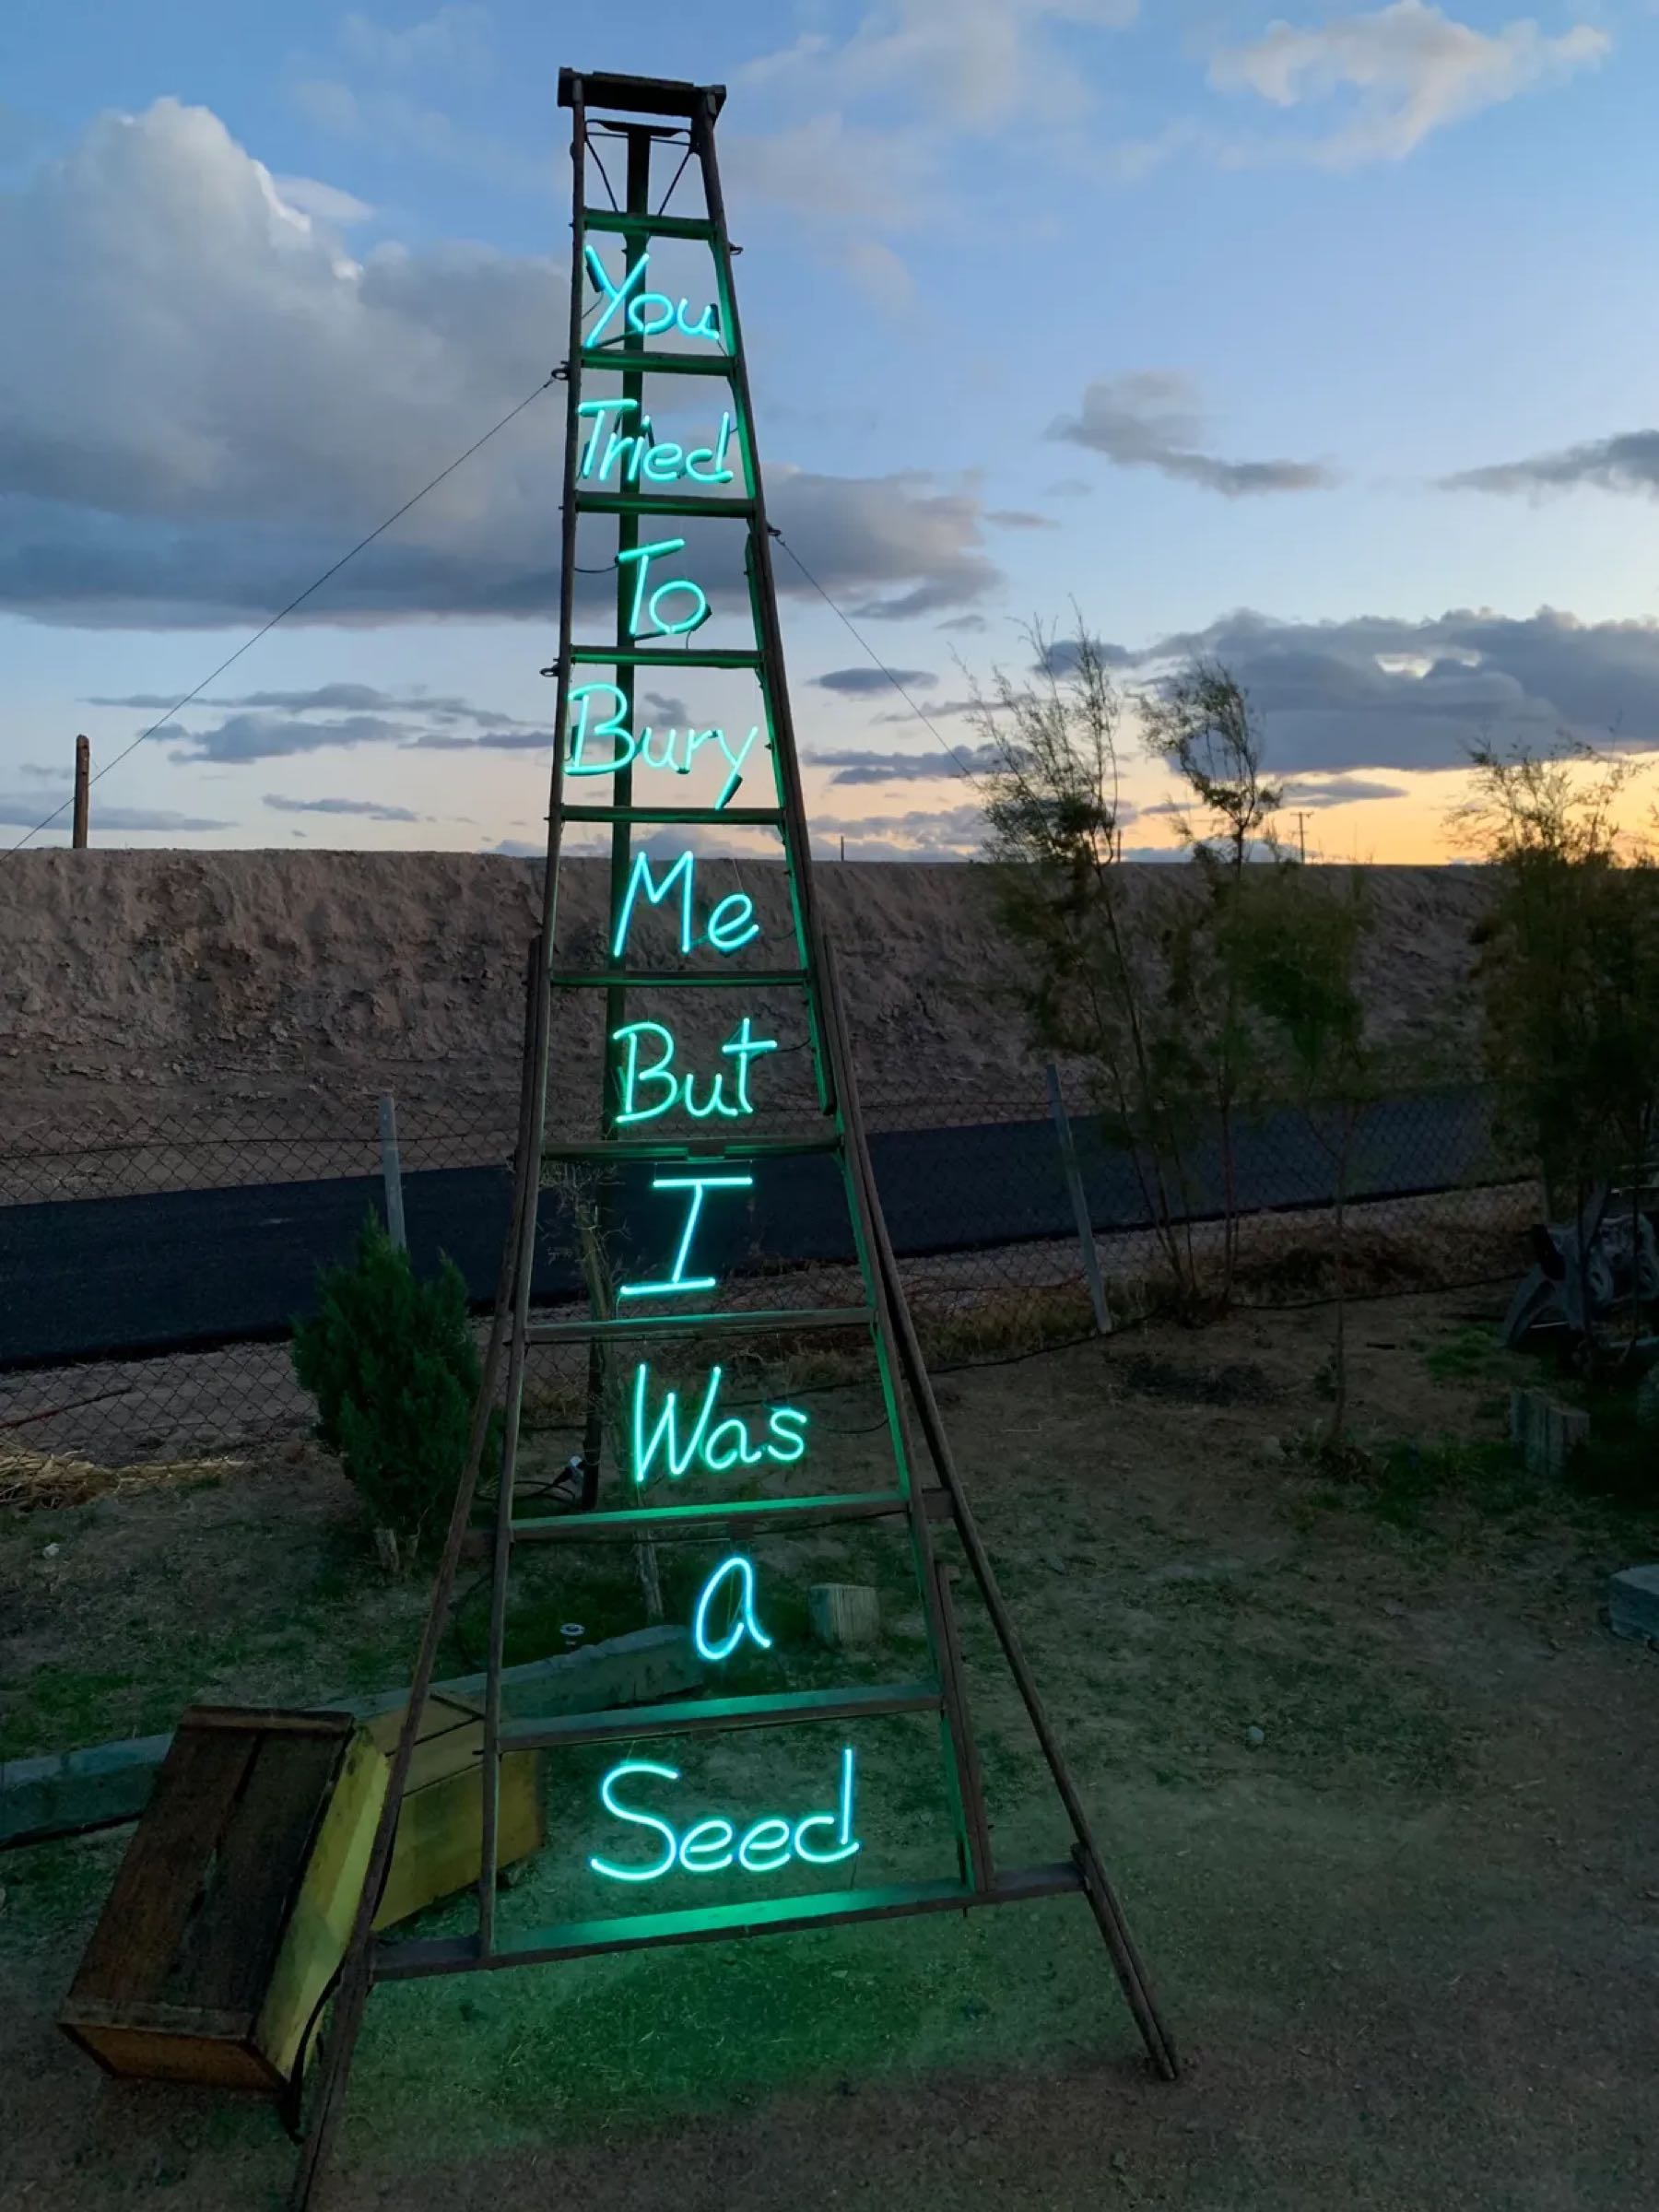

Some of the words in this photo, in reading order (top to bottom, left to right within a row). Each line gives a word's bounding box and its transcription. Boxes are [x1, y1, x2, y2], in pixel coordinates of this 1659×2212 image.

[583, 244, 720, 348] You
[578, 398, 734, 484] Tried
[618, 538, 707, 637] To
[563, 680, 758, 810] Bury
[613, 851, 759, 958] Me
[612, 1018, 778, 1124] But
[619, 1176, 753, 1296] I
[633, 1363, 807, 1483] Was
[695, 1557, 772, 1661] a
[589, 1747, 860, 1882] Seed
